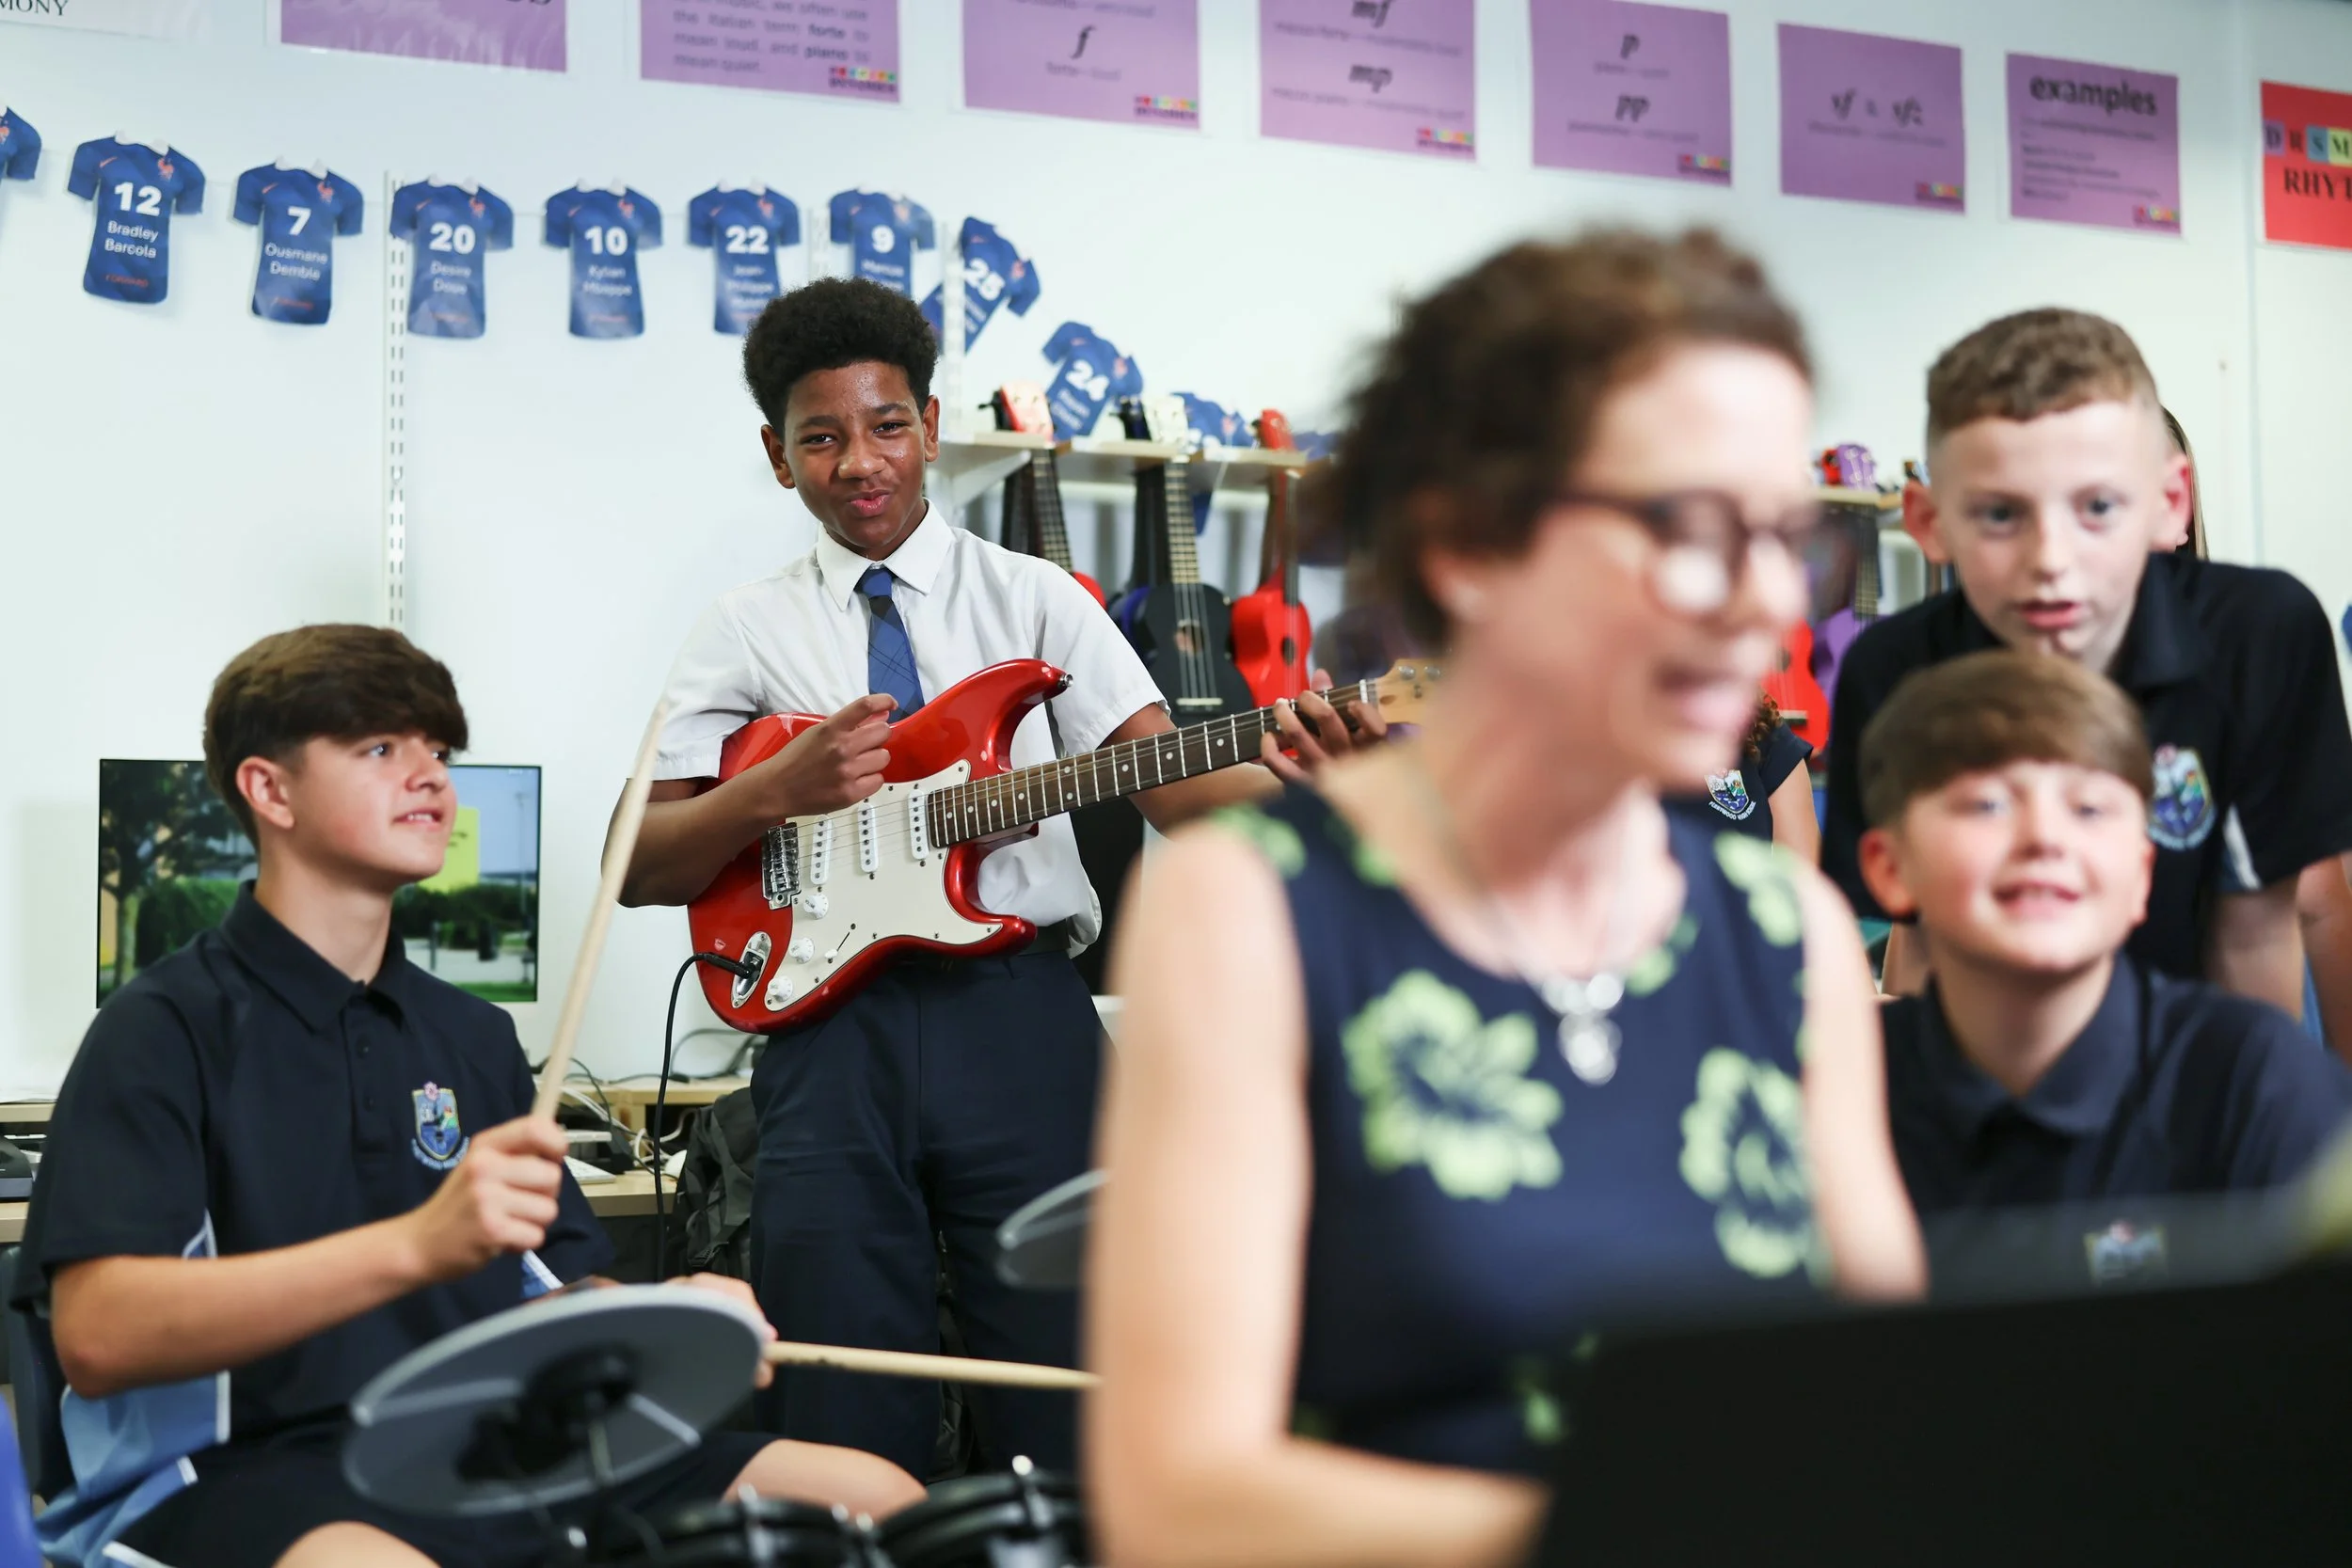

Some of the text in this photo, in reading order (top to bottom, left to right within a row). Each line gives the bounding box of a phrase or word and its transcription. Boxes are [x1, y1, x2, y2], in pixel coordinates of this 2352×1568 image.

[1069, 24, 1097, 60] f
[2028, 75, 2159, 118] examples
[114, 181, 162, 217] 12
[106, 220, 159, 244] Bradley
[287, 205, 311, 236] 7
[104, 238, 157, 260] Barcola
[264, 242, 329, 265] Ousmane
[429, 222, 476, 255] 20
[584, 225, 629, 256] 10
[725, 225, 771, 255] 22
[871, 224, 896, 254] 9
[960, 256, 1006, 301] 25
[1065, 358, 1110, 403] 24
